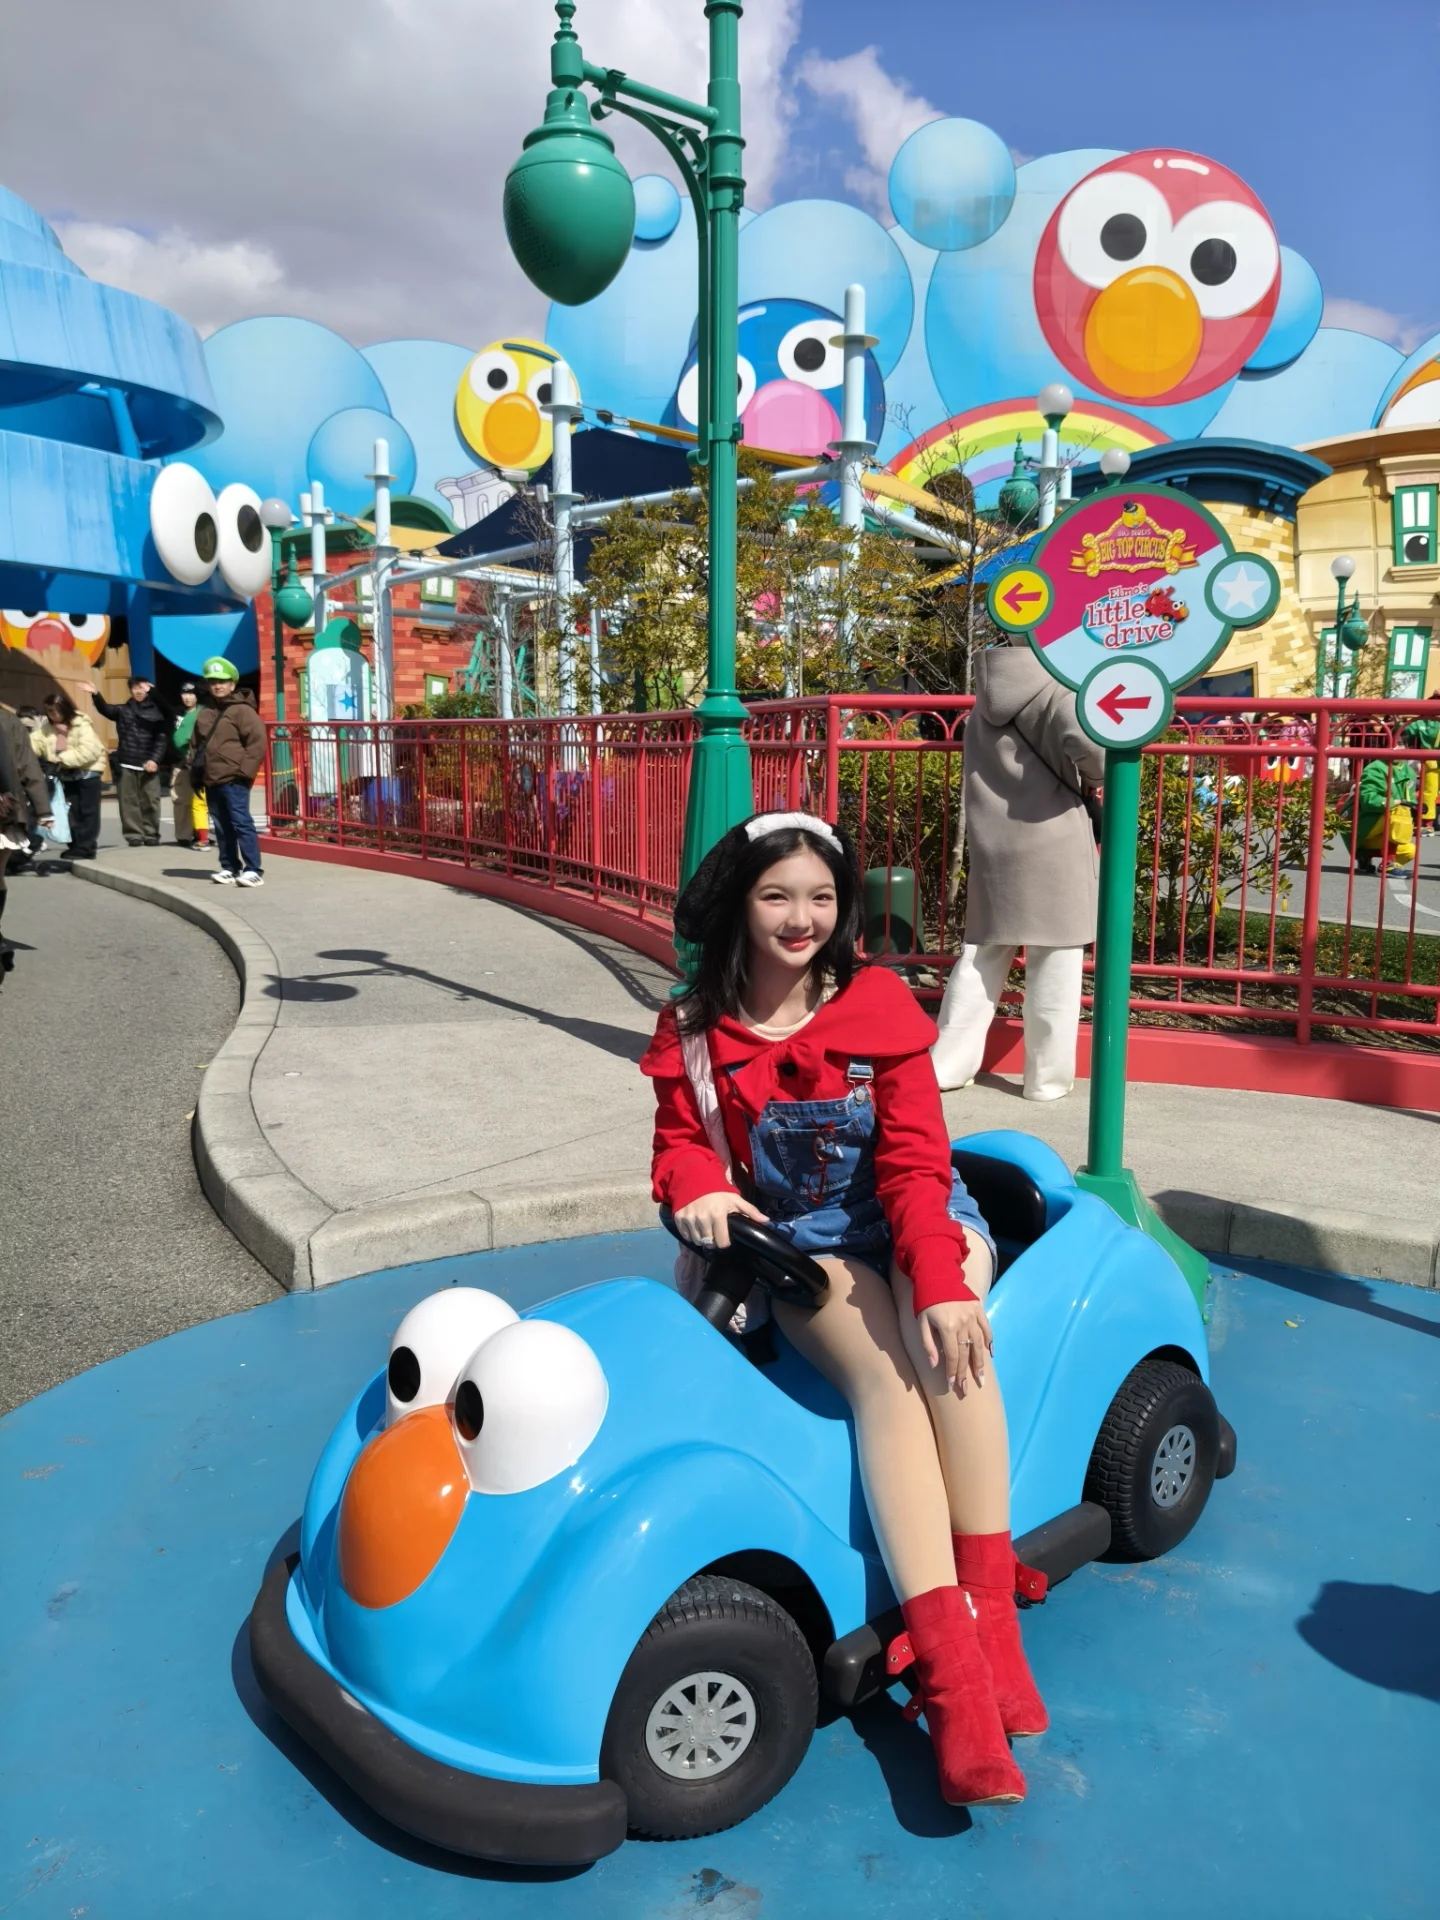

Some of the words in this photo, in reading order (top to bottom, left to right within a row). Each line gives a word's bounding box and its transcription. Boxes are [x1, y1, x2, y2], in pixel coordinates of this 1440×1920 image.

[1100, 540, 1117, 562] BIG
[1116, 538, 1134, 559] TOP
[1134, 537, 1168, 560] CIRCUS
[1109, 583, 1149, 599] Elmo's
[1087, 600, 1145, 628] little
[1104, 620, 1172, 648] drive
